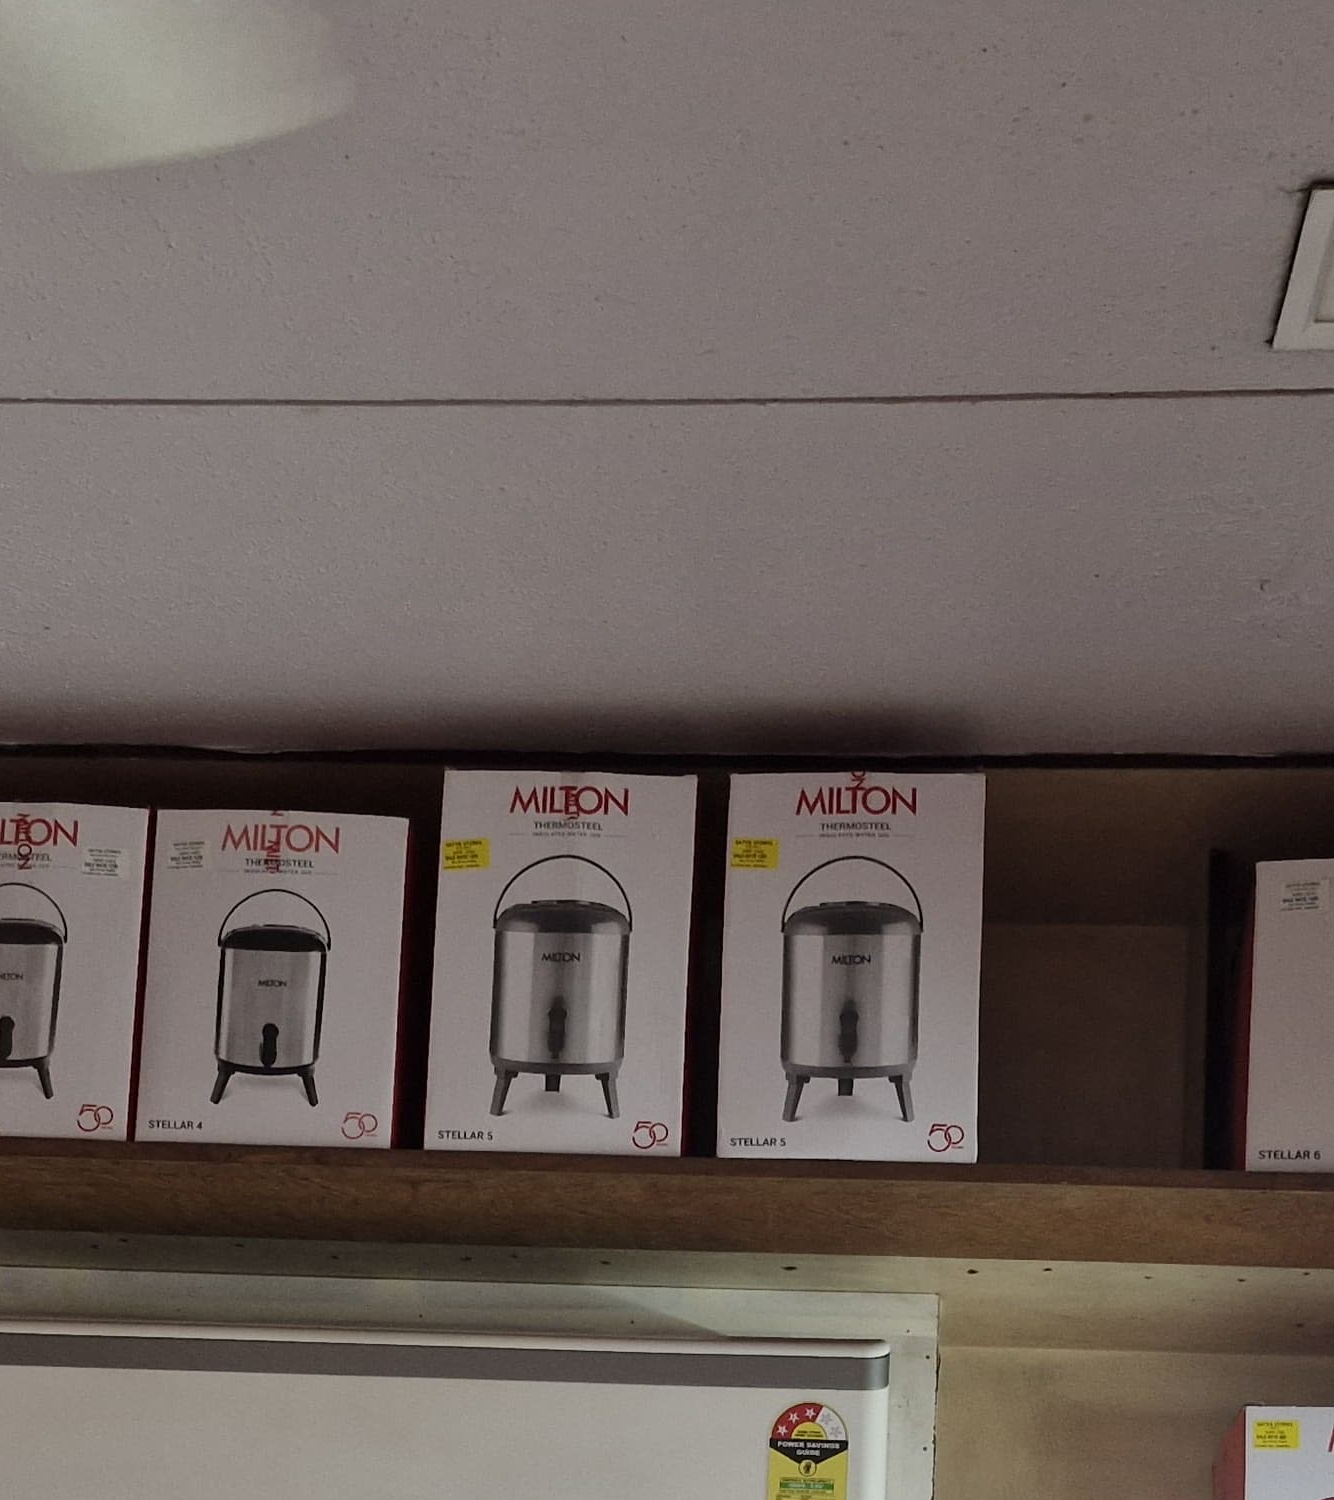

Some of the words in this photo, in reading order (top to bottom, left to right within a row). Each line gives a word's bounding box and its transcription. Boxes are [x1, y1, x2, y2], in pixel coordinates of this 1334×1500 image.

[510, 785, 629, 817] MILTON
[796, 786, 917, 816] MILTON
[222, 823, 340, 854] MILTON
[542, 953, 580, 963] MILTON
[832, 955, 871, 965] MILTON
[148, 1120, 195, 1130] STELLAR
[197, 1121, 203, 1130] 4
[438, 1131, 484, 1140] STELLAR
[487, 1131, 493, 1140] 5
[730, 1138, 777, 1147] STELLAR
[780, 1138, 786, 1147] 5
[1258, 1150, 1312, 1160] STELLAR
